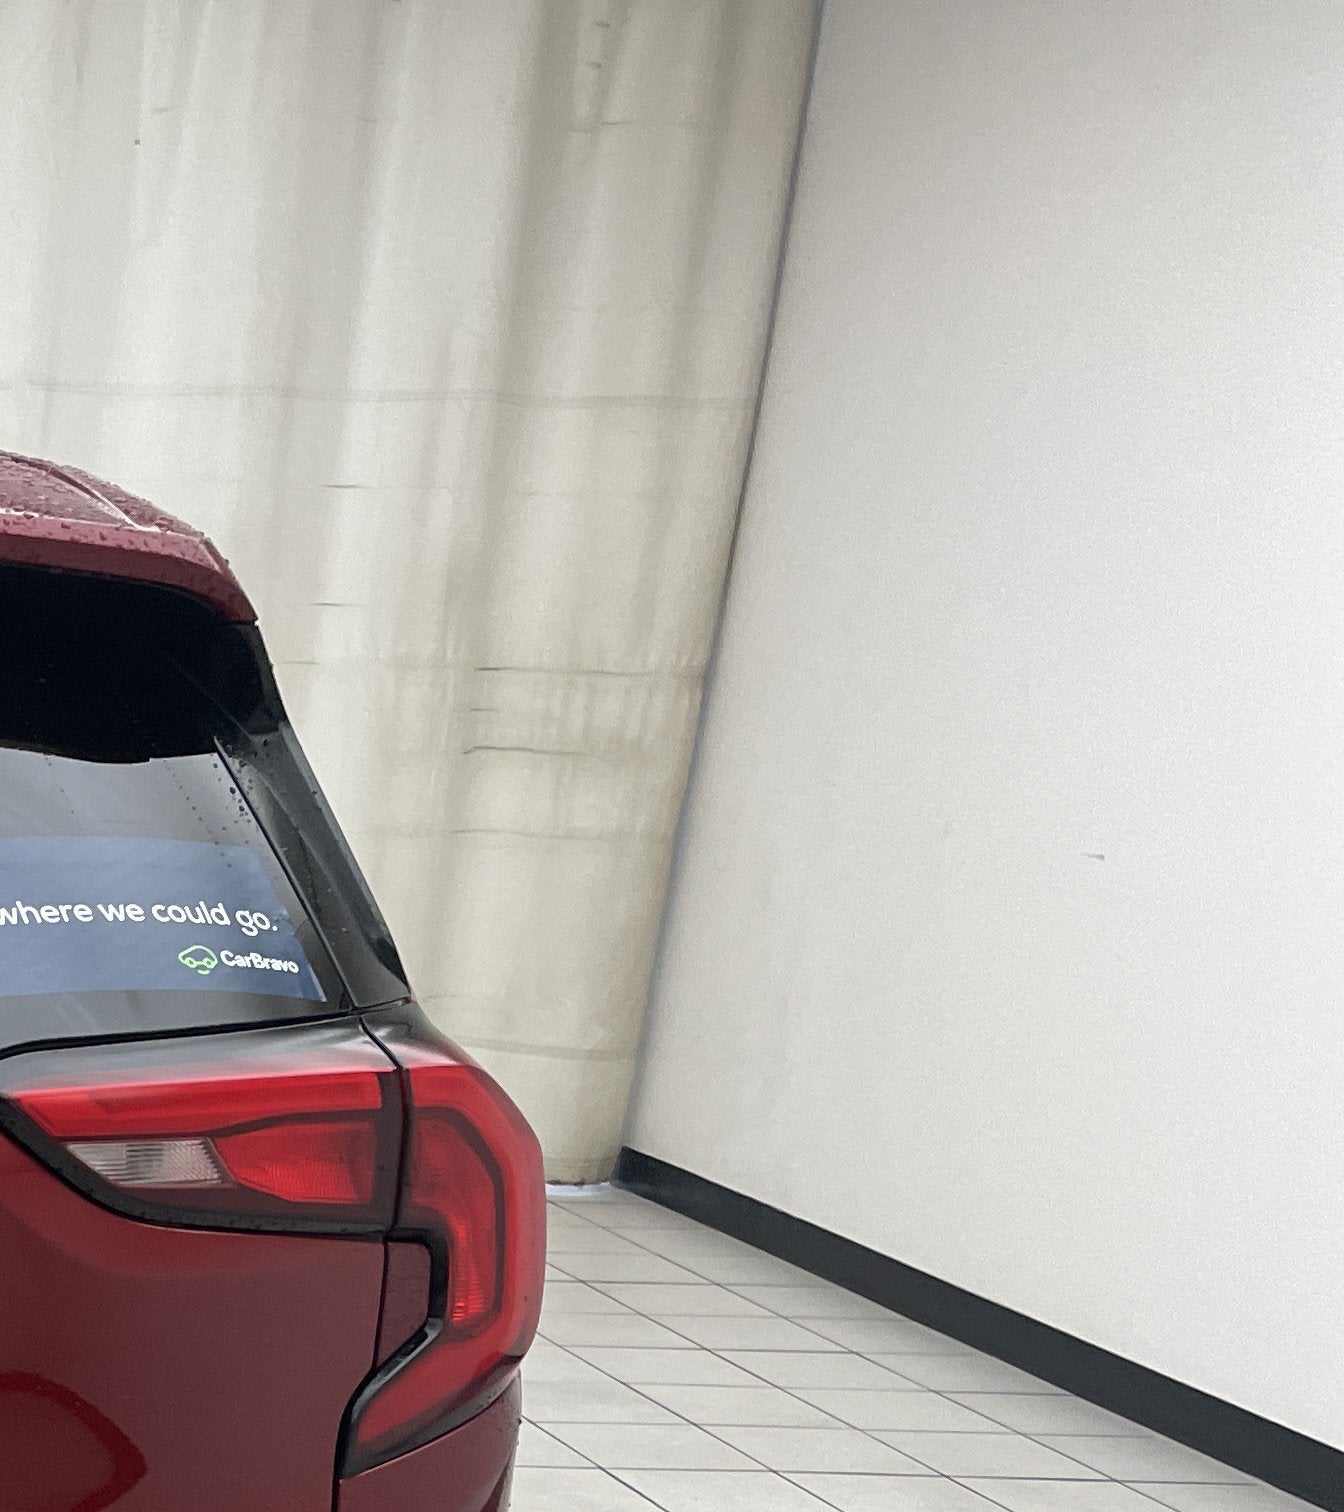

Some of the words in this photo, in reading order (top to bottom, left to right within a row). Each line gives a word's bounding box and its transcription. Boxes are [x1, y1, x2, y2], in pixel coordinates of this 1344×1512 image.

[97, 901, 146, 923] we
[151, 900, 231, 927] could
[235, 908, 279, 937] go.
[219, 949, 300, 974] CarBravo
